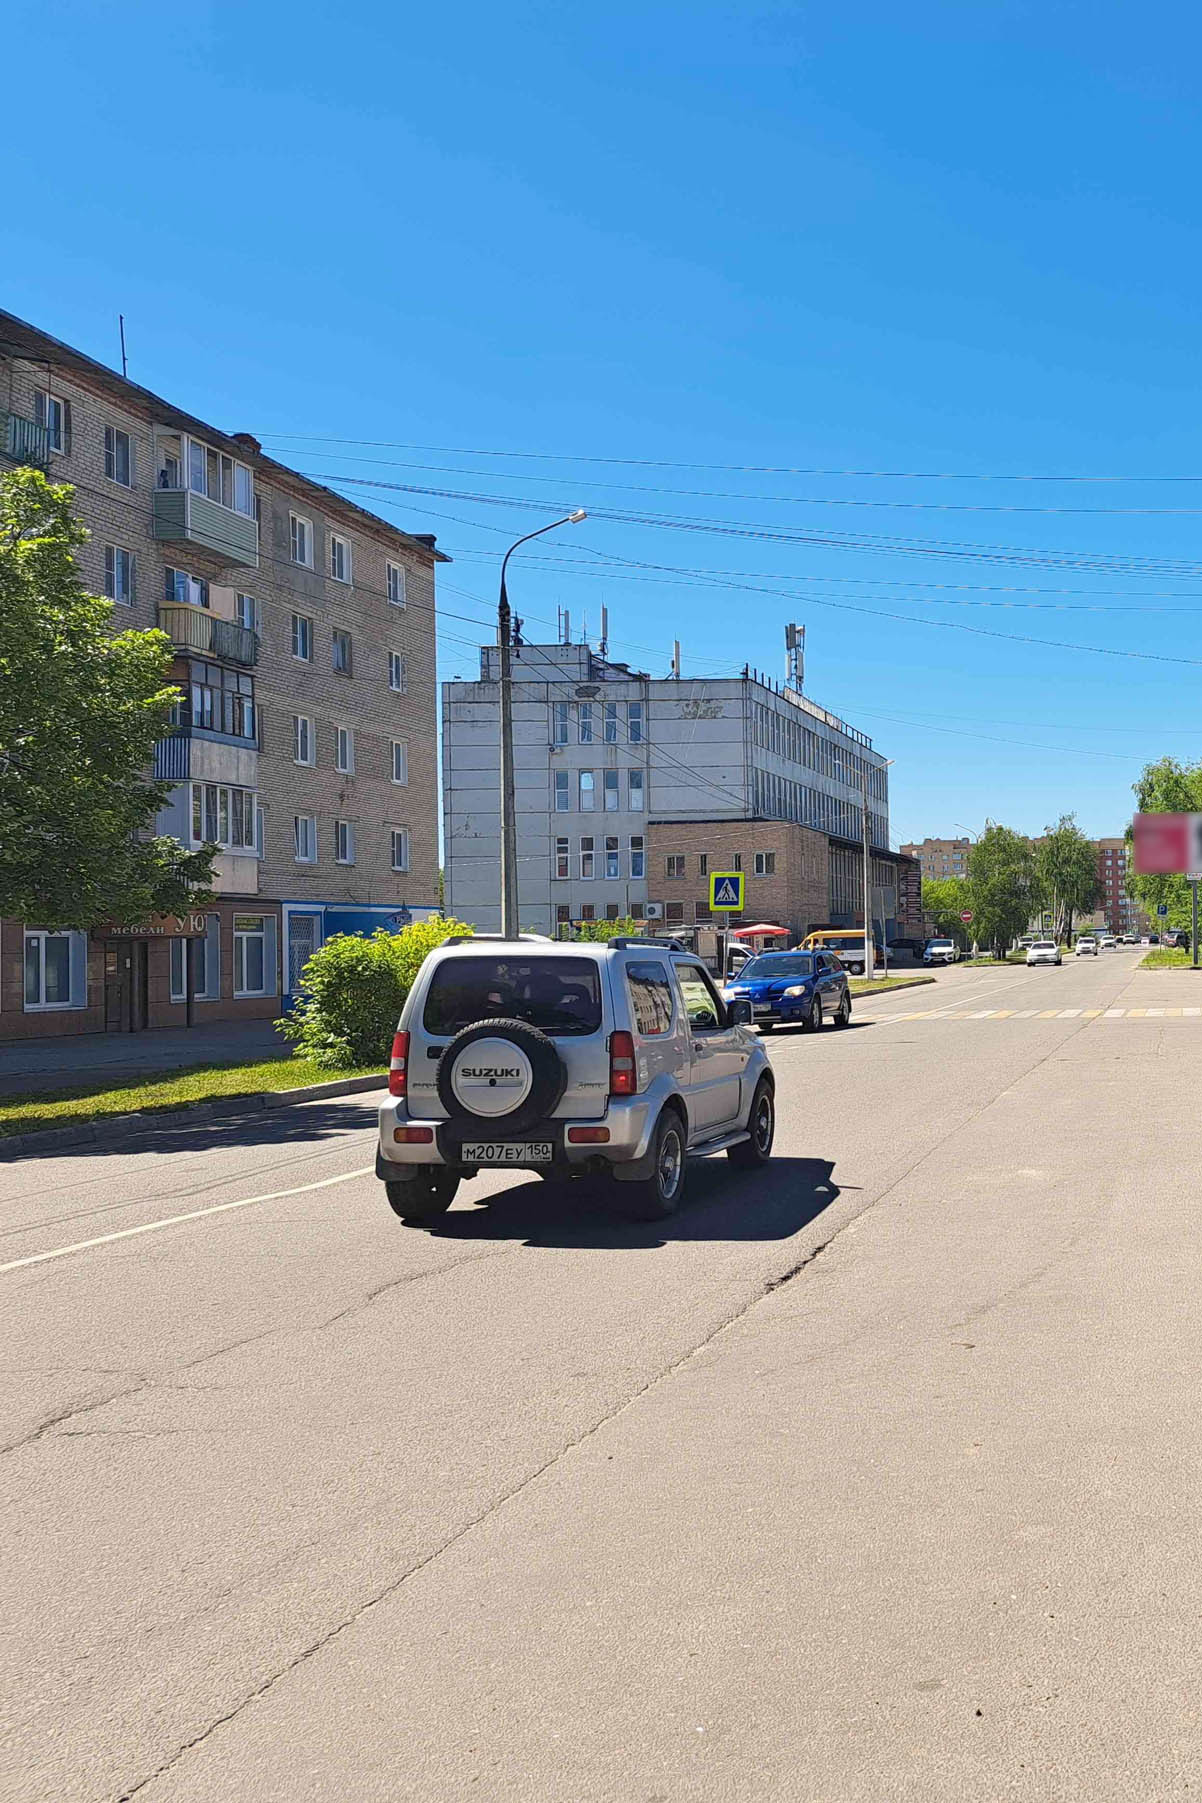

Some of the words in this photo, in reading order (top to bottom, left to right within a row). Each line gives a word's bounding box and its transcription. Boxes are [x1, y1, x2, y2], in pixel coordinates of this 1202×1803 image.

[111, 923, 165, 935] мебели
[175, 914, 208, 933] УЮ
[461, 1067, 520, 1078] SUZUKI
[466, 1145, 523, 1160] М207ЕУ
[527, 1144, 549, 1155] 150
